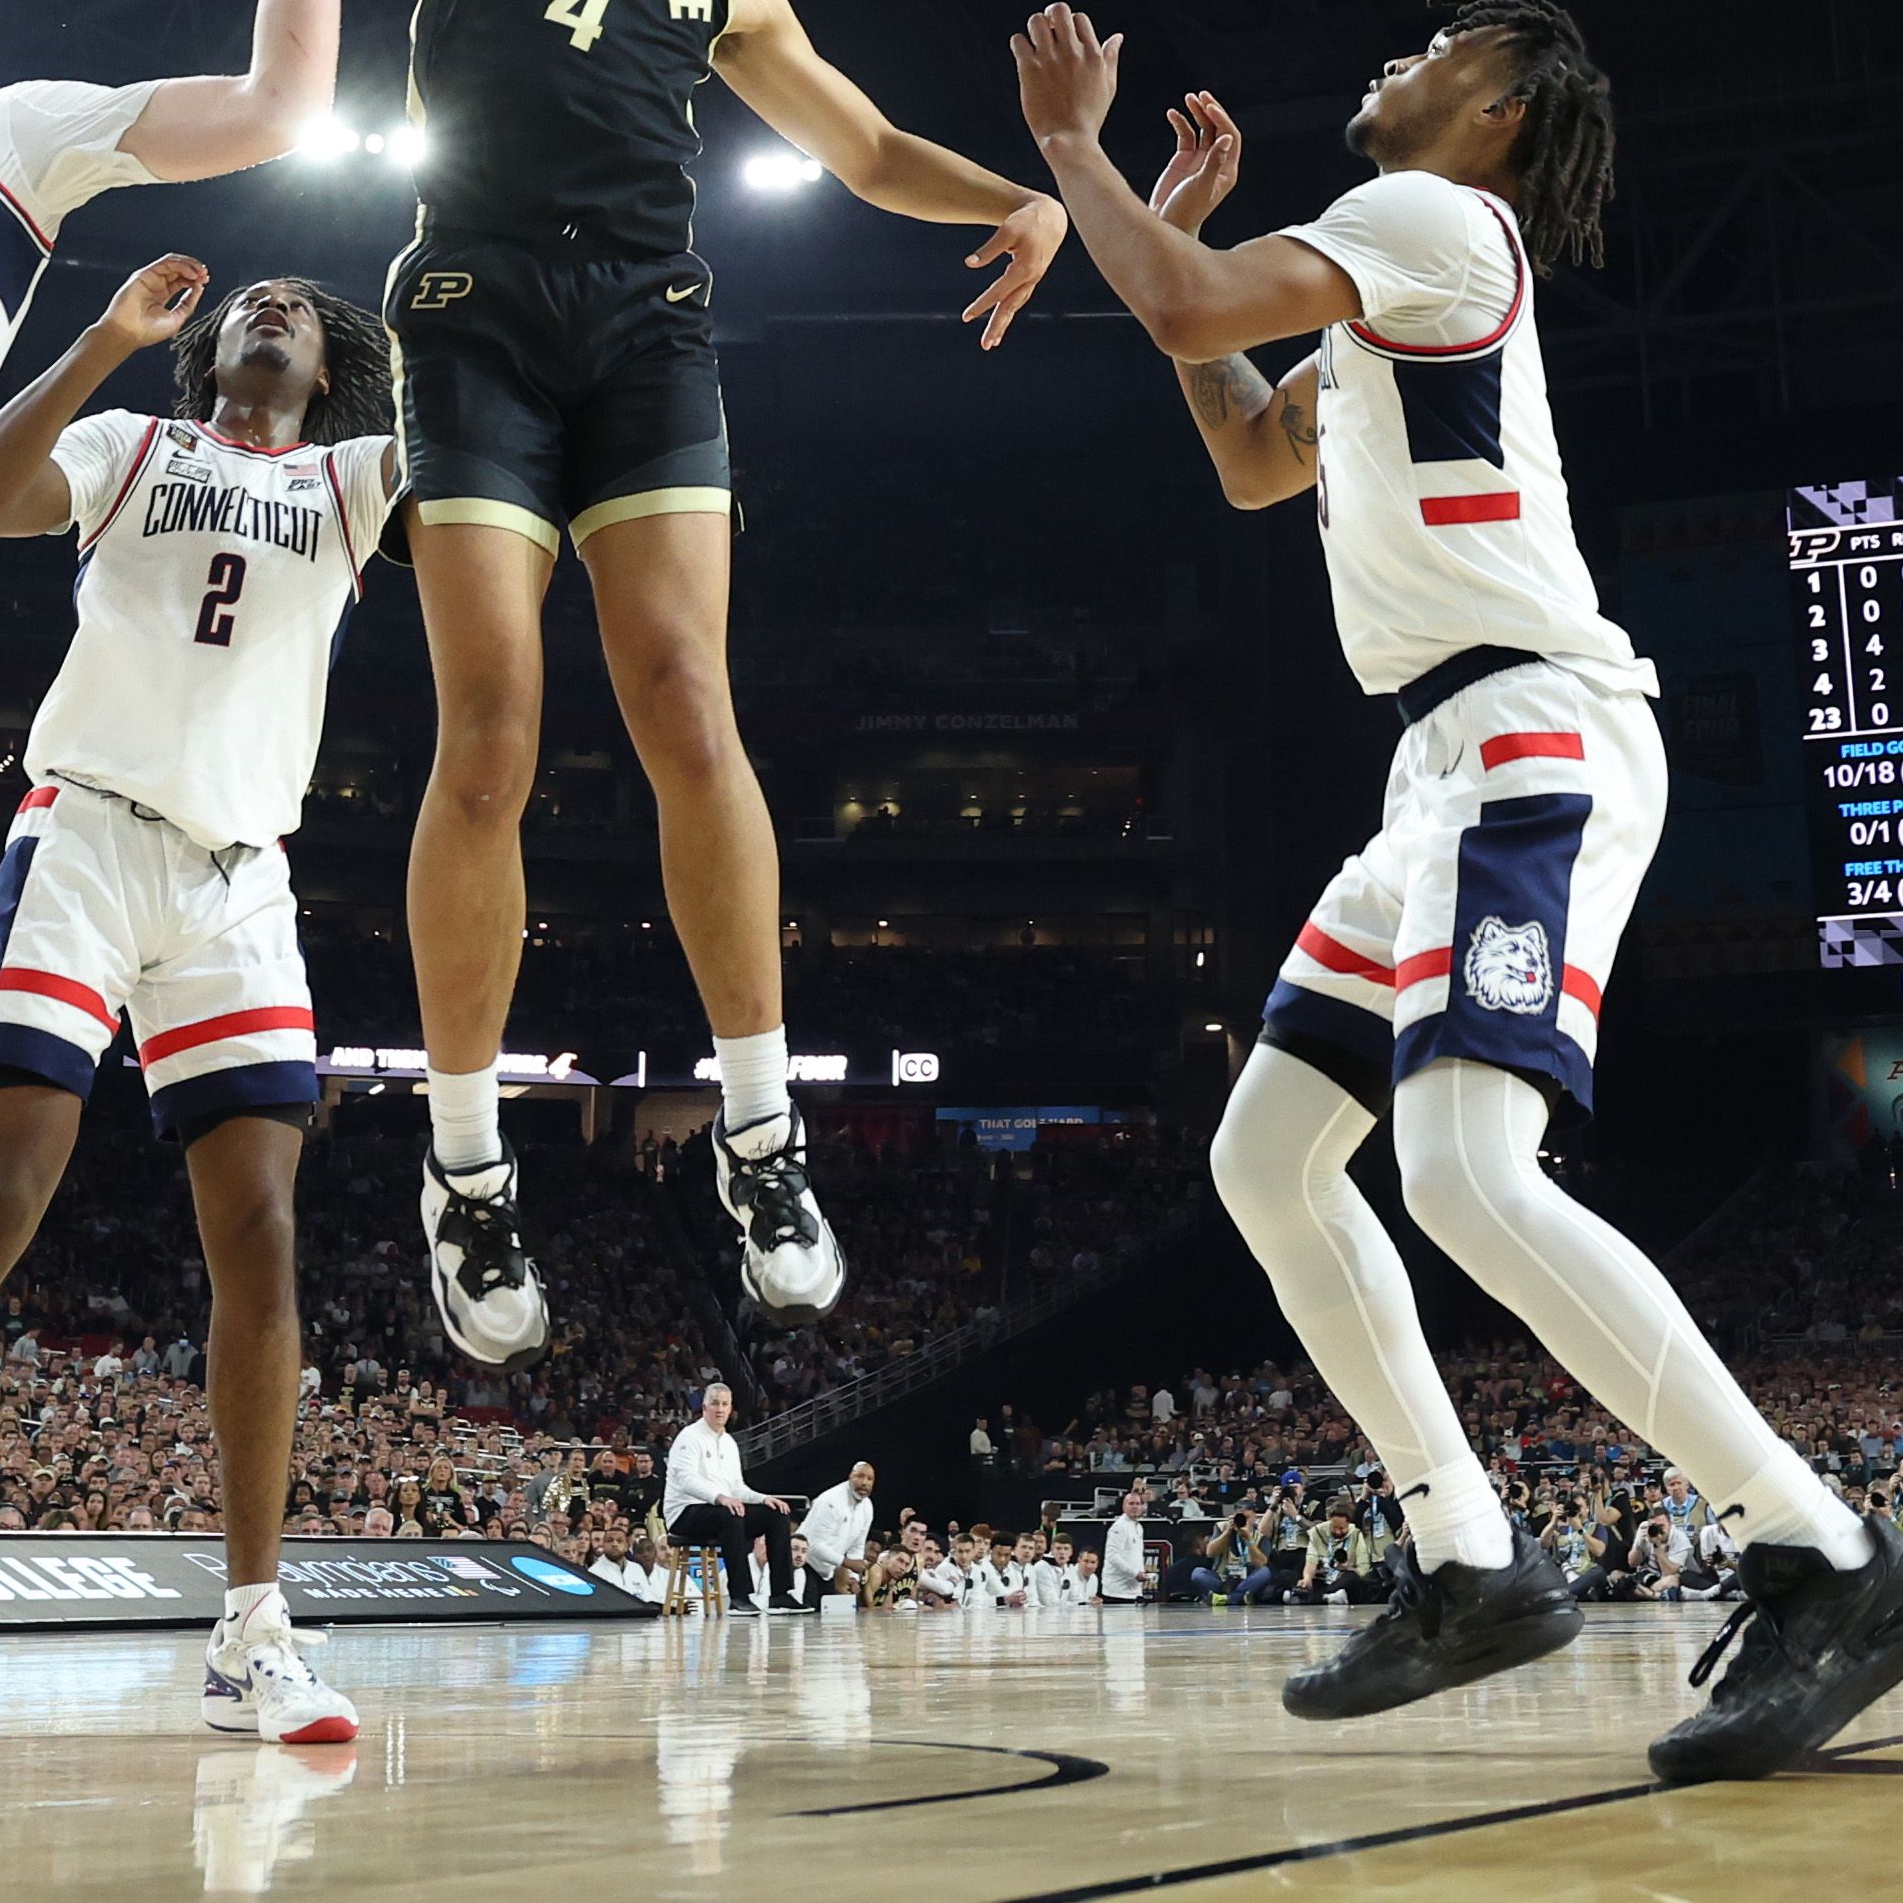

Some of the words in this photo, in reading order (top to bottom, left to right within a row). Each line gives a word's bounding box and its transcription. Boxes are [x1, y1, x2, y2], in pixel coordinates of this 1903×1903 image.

[142, 481, 324, 564] CONNECTICUT
[1850, 535, 1880, 550] PTS
[1808, 572, 1820, 592] 1
[193, 552, 246, 647] 2
[1808, 605, 1826, 627] 2
[1812, 639, 1828, 661] 3
[1866, 634, 1883, 655] 4
[1813, 673, 1833, 695] 4
[1870, 669, 1885, 690] 2
[855, 714, 927, 730] JIMMY
[935, 713, 1079, 730] CONZELMAN
[1809, 707, 1841, 730] 23
[1841, 741, 1884, 758] FIELD
[1824, 761, 1895, 787] 10/18
[1839, 802, 1889, 818] THREE
[1850, 820, 1889, 845] 0/1
[1844, 861, 1883, 877] FREE
[1848, 880, 1892, 905] 3/4
[330, 1047, 376, 1068] AND
[548, 1053, 578, 1081] 4
[905, 1059, 933, 1077] CC
[979, 1119, 1011, 1129] THAT
[183, 1553, 450, 1588] Palympians
[303, 1588, 379, 1599] MADE
[377, 1588, 446, 1598] HERE
